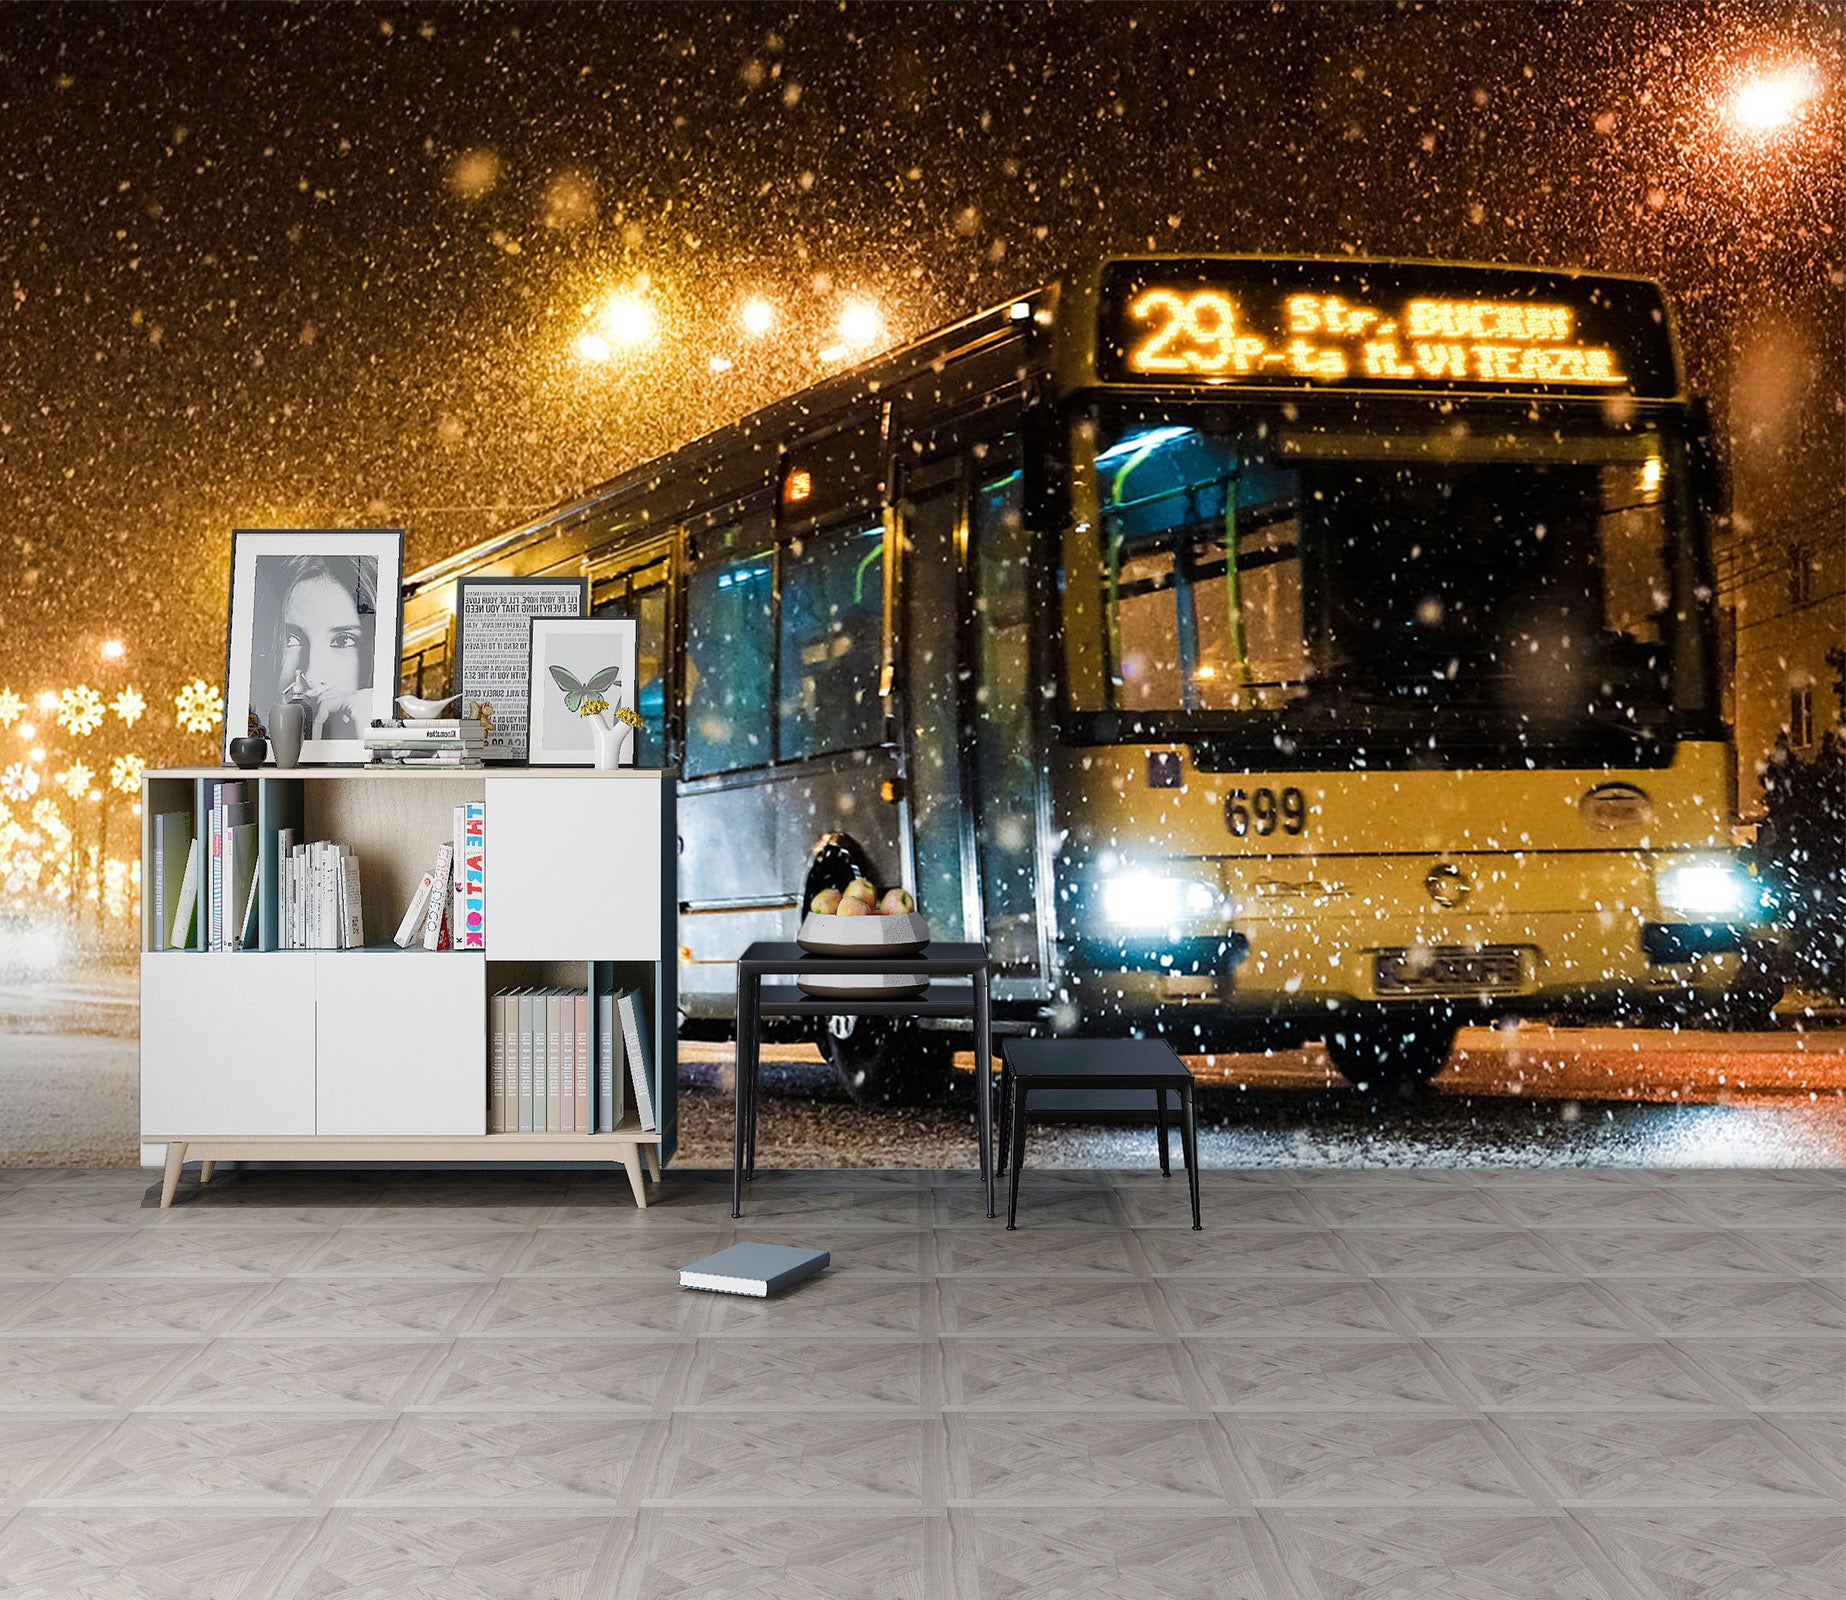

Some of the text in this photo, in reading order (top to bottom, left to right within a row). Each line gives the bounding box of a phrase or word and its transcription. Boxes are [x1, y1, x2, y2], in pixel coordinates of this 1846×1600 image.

[1134, 292, 1236, 370] 29
[1290, 297, 1397, 332] Str.
[1225, 787, 1305, 837] 699
